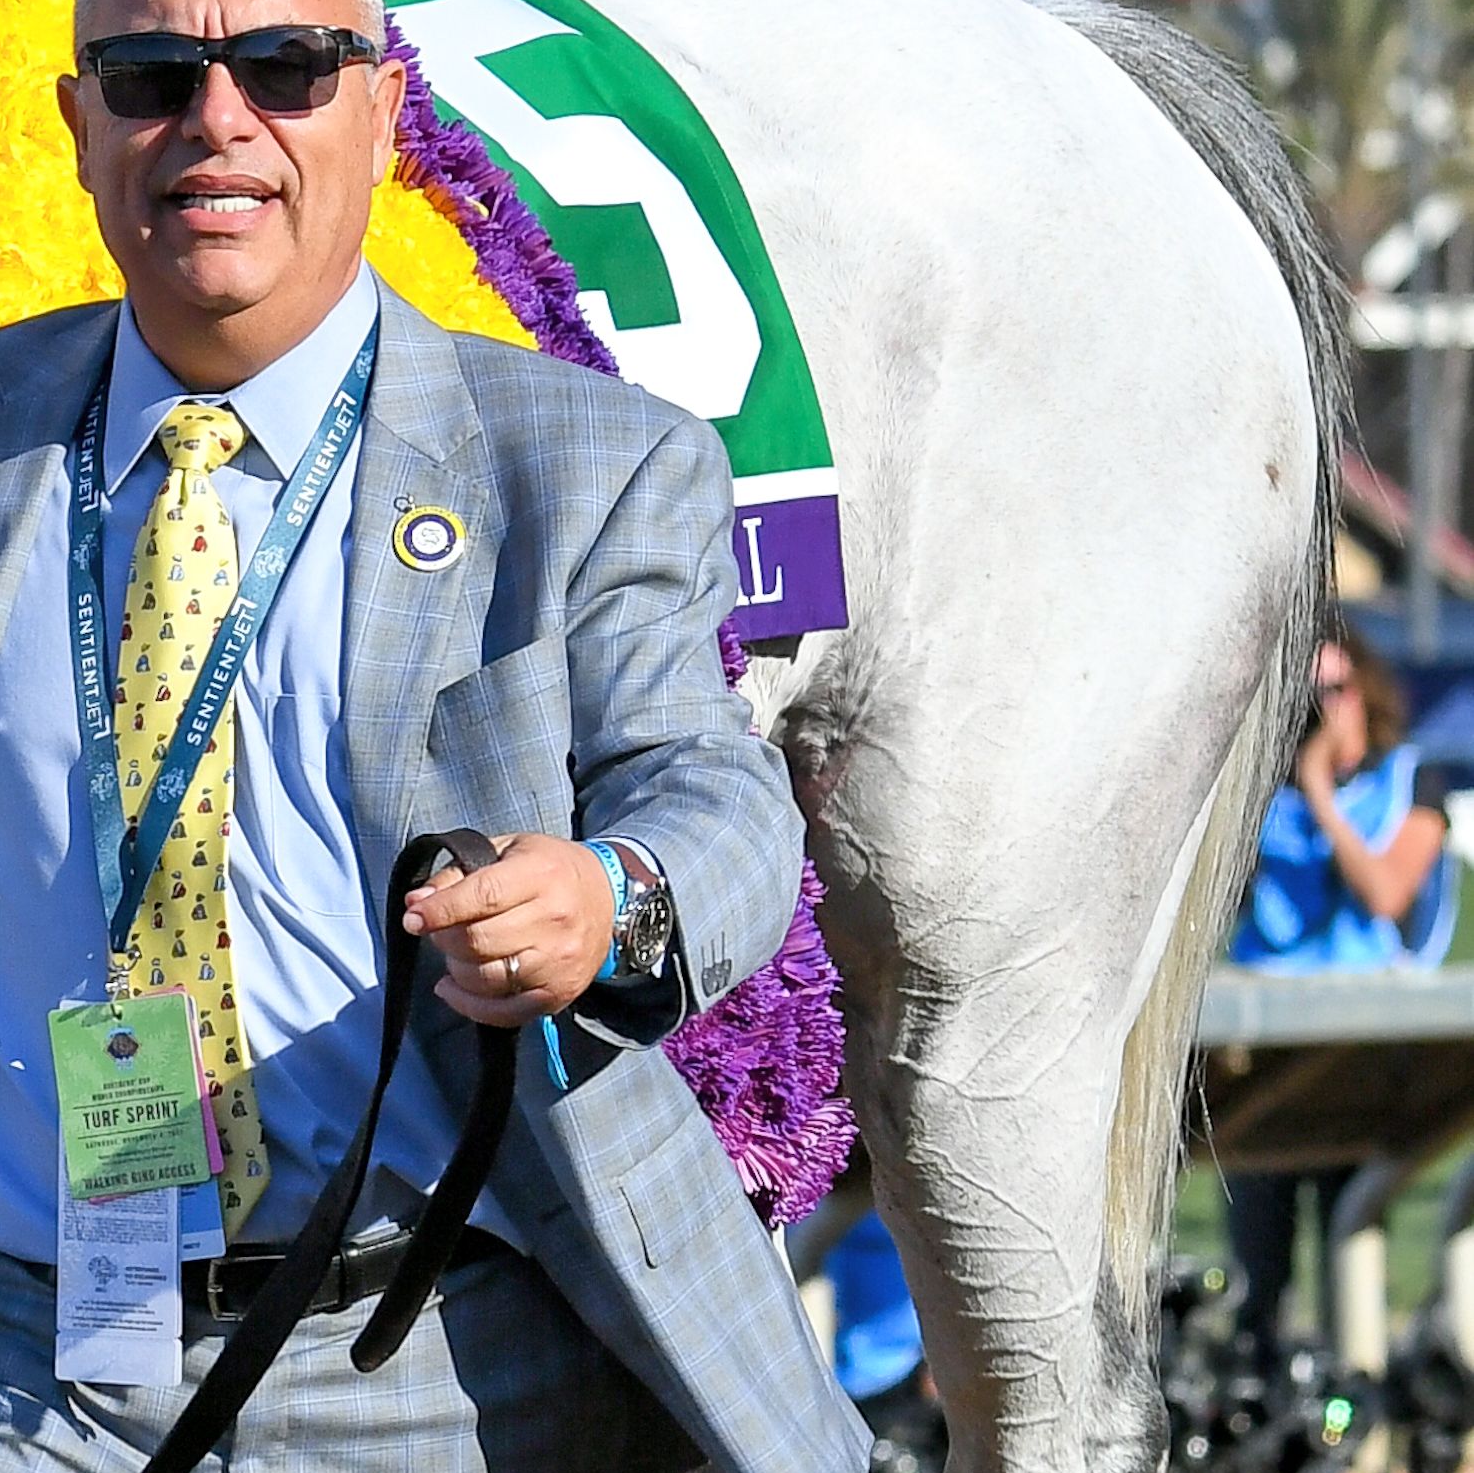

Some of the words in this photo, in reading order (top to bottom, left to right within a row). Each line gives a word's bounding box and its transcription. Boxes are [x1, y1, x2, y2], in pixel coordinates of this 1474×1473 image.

[82, 1107, 120, 1130] TURF
[126, 1100, 179, 1124] SPRINT
[158, 1163, 197, 1181] ACCESS
